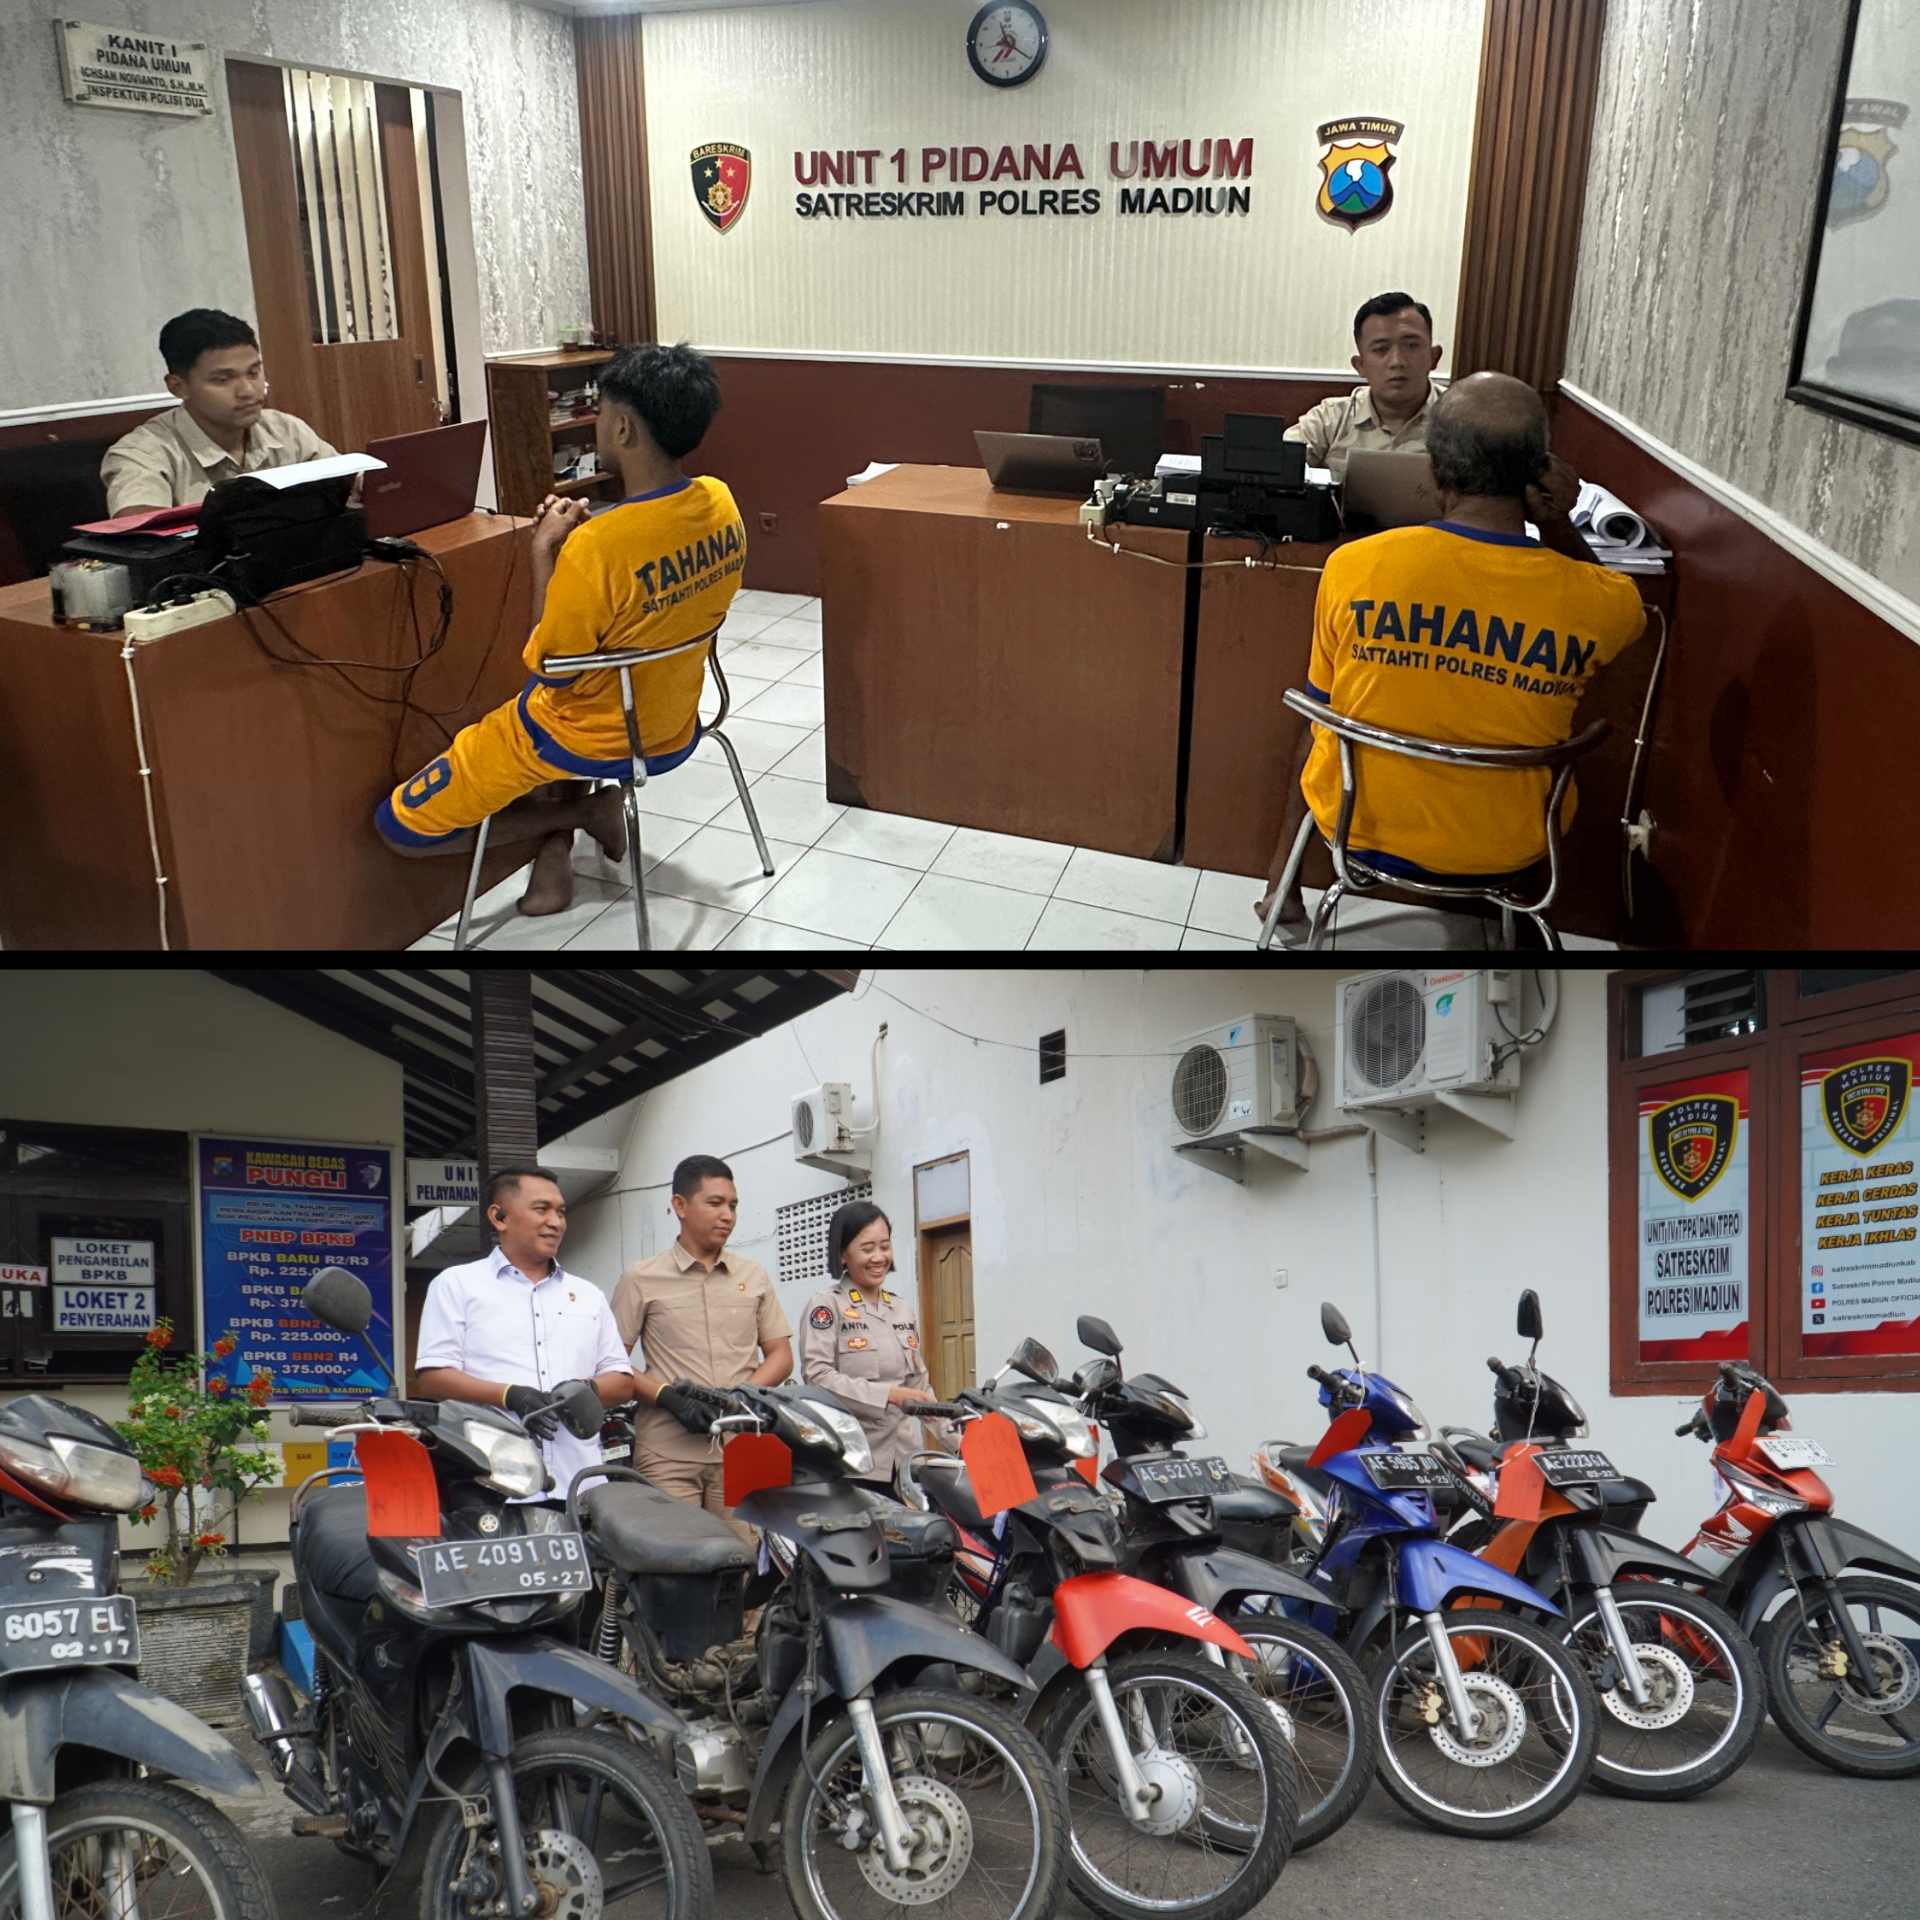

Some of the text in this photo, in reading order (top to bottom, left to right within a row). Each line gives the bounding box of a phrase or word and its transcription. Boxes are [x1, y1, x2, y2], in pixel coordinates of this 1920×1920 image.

[108, 34, 177, 57] KANIT I
[96, 48, 192, 75] PIDANA UMUM
[88, 85, 206, 109] INSPEKTUR POLISI DUA
[1324, 122, 1397, 136] JAWA TIMUR
[692, 144, 745, 159] BARESKRIM
[793, 138, 1255, 187] UNIT 1 PIDANA UMUM
[795, 187, 1251, 218] SATRESKRIM POLRES MADIUN
[1350, 599, 1596, 677] TAHANAN
[1351, 643, 1429, 670] SATTAHTI
[1435, 654, 1508, 685] POLRES
[401, 757, 453, 810] 8
[1668, 1102, 1718, 1119] POLRES
[1668, 1113, 1719, 1129] MADIUN
[246, 1151, 346, 1170] KAWASAN BEBAS
[245, 1166, 347, 1190] PUNGLI
[444, 1164, 479, 1181] UNI
[1820, 1160, 1914, 1186] KERJA KERAS
[416, 1184, 479, 1202] PELAYANAN
[1816, 1182, 1918, 1208] KERJA CERDAS
[1816, 1204, 1919, 1229] KERJA TUNTAS
[240, 1228, 355, 1247] PNBP BPKB
[1647, 1221, 1665, 1243] UNIT
[1699, 1215, 1716, 1238] DAN
[1817, 1226, 1917, 1250] KERJA IKHLAS
[75, 1242, 132, 1255] LOKET
[57, 1254, 149, 1268] PENGAMBILAN
[226, 1251, 369, 1266] BPKB BARU R2/R3
[1657, 1246, 1730, 1278] SATRESKRIM
[2, 1267, 41, 1282] UKA
[80, 1269, 128, 1281] BPKB
[248, 1265, 322, 1277] Rp. 225.0
[241, 1284, 286, 1296] BPKB
[1648, 1283, 1740, 1315] POLRES MADIUN
[1890, 1293, 1920, 1303] OFFICIA
[64, 1290, 146, 1310] LOKET 2
[250, 1297, 275, 1309] Rp.
[59, 1312, 151, 1328] PENYERAHAN
[229, 1317, 274, 1328] BPKB
[251, 1331, 351, 1343] Rp. 225.000,-
[243, 1351, 287, 1361] BPKB
[338, 1352, 358, 1362] R4
[282, 1364, 352, 1375] 375.000,-
[1138, 1466, 1162, 1482] AE
[1164, 1461, 1203, 1479] 5215
[433, 1538, 579, 1575] AE 4091 CB
[5, 1606, 127, 1641] 6057 EL
